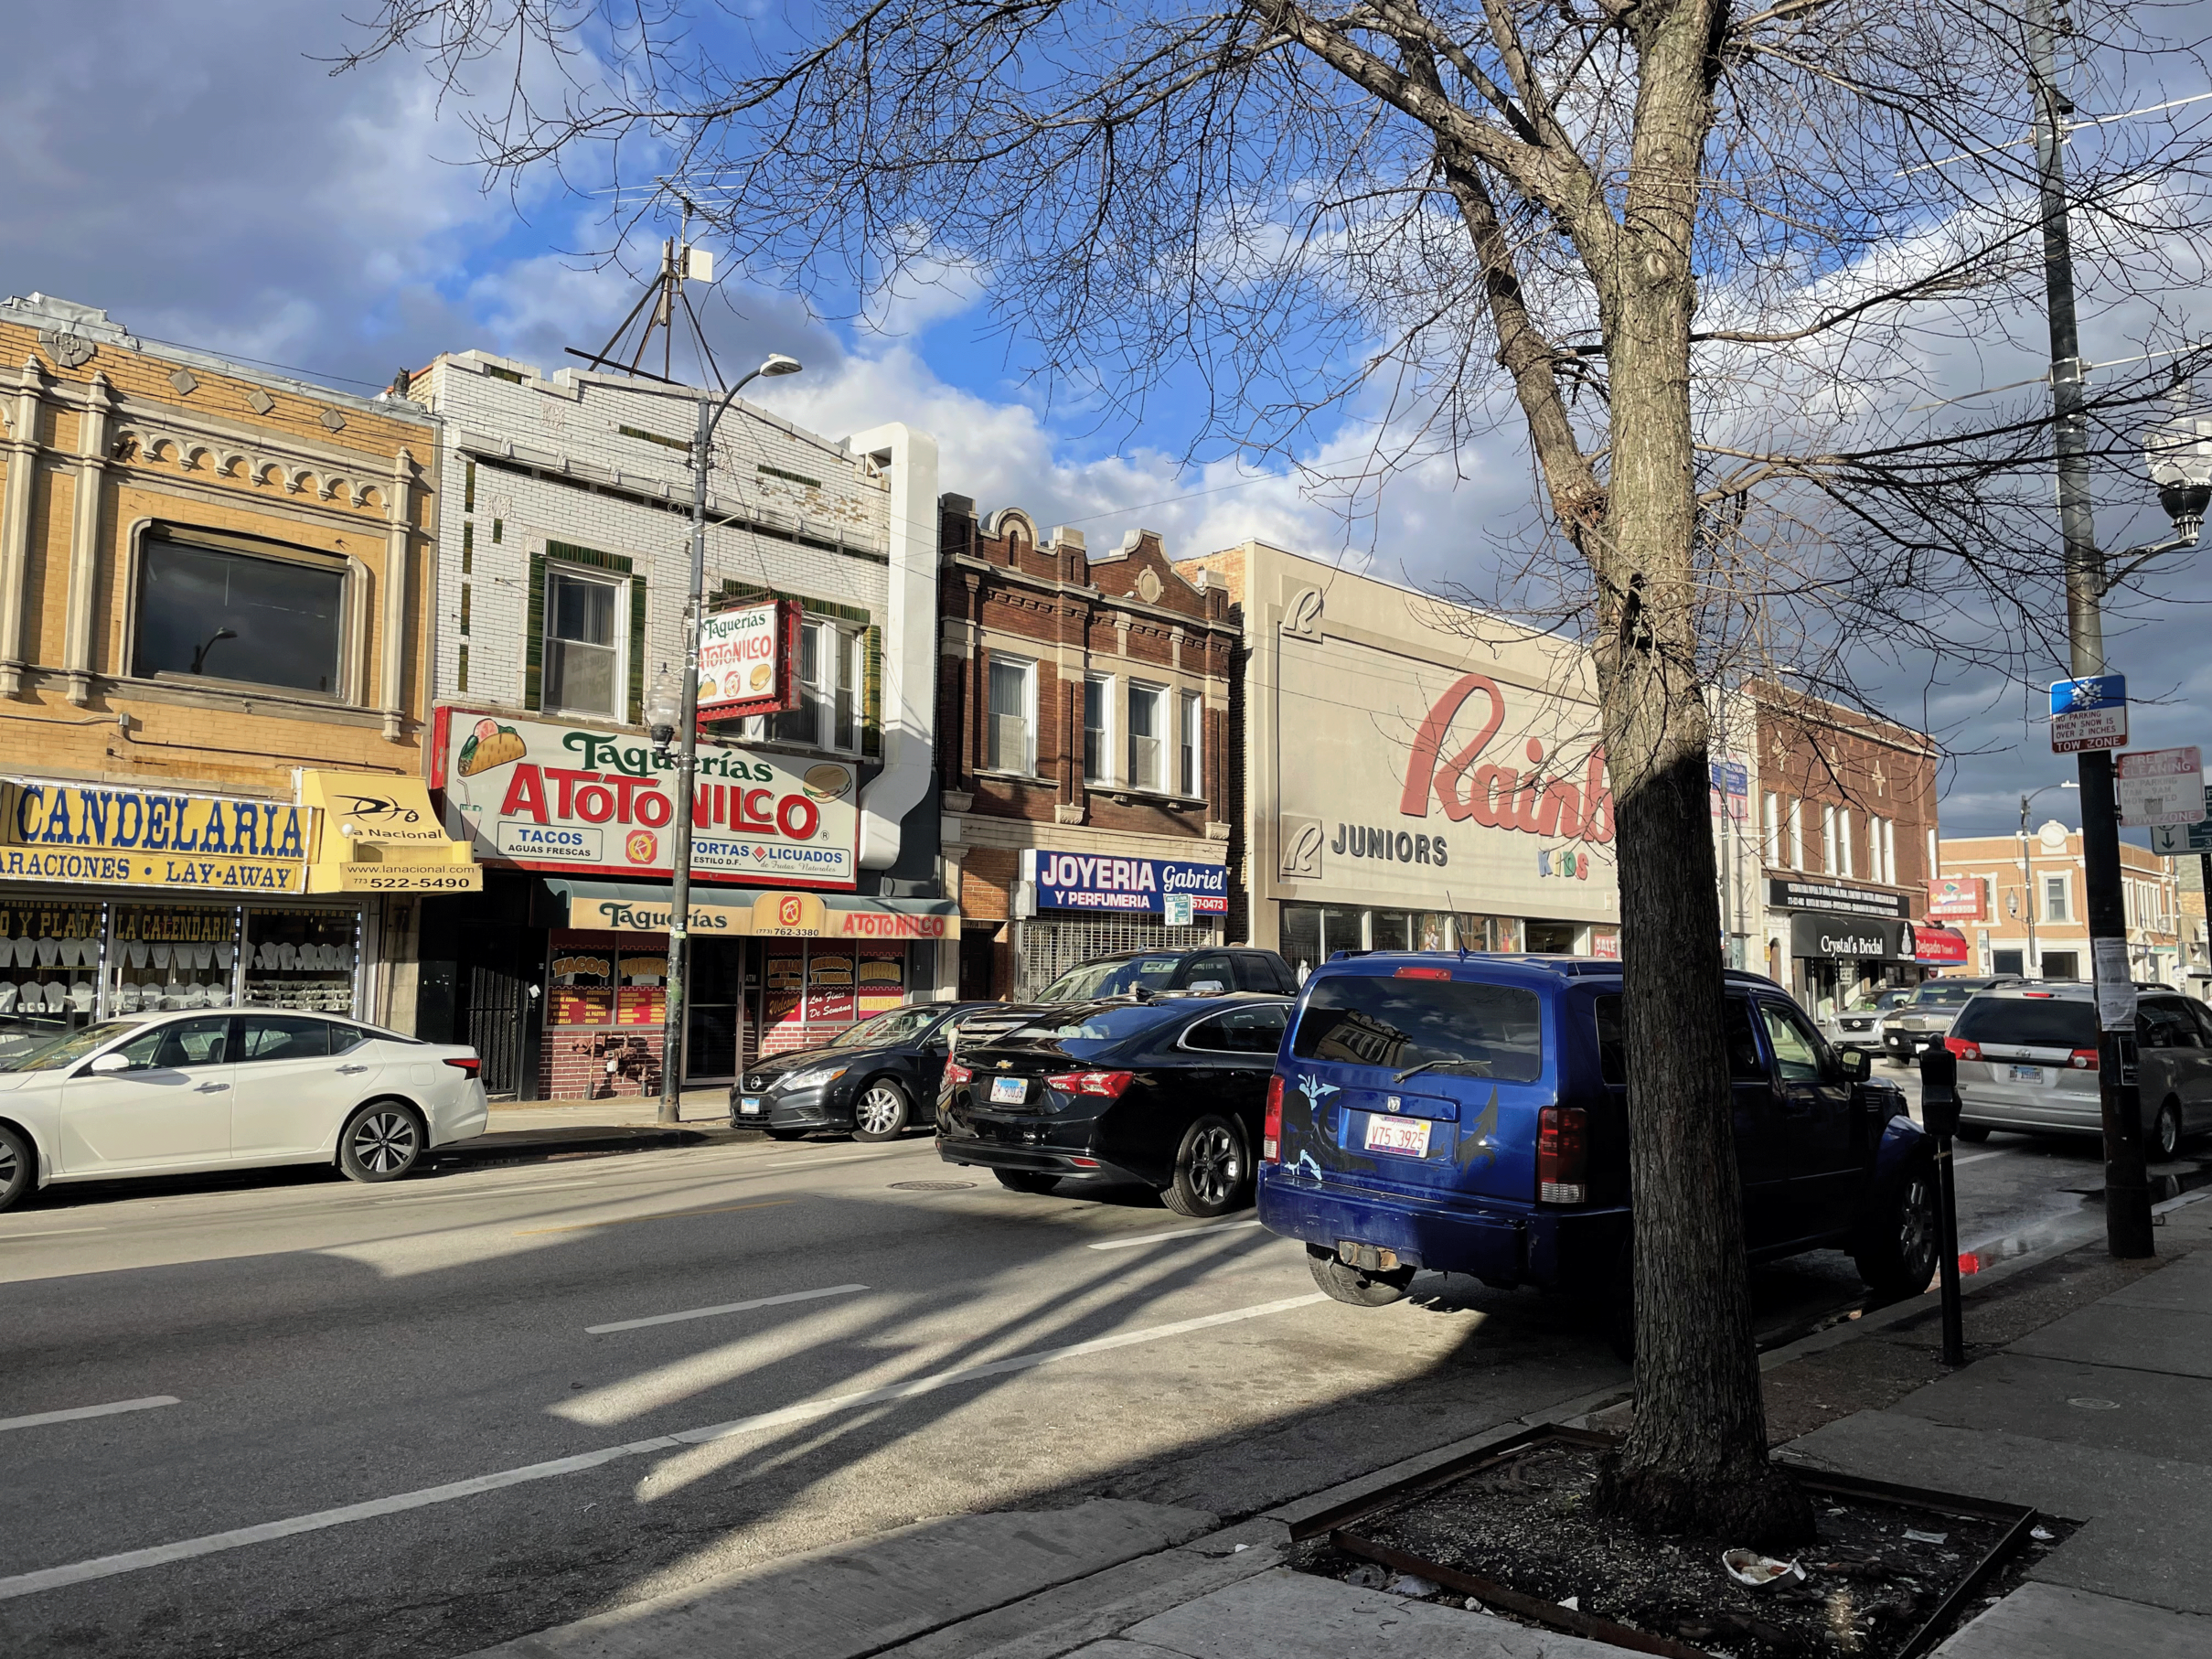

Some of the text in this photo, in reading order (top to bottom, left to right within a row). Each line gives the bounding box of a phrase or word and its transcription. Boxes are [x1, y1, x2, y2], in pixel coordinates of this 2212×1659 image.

[701, 611, 766, 640] Taquerías
[2056, 717, 2114, 731] WHEN SNOW IS
[2069, 711, 2101, 721] PARKING
[2056, 730, 2075, 739] OVER
[2088, 724, 2116, 735] INCHES
[2057, 735, 2121, 752] TOW ZONE
[1400, 673, 1618, 843] Rainb
[2121, 761, 2191, 777] CLEANING
[2140, 777, 2177, 787] PARKING
[500, 763, 819, 840] ATOTONILCO
[17, 785, 304, 858] CANDELARIA
[2160, 810, 2196, 822] ZONE
[369, 829, 442, 839] Nacional
[518, 829, 583, 845] TACOS
[508, 844, 591, 856] AGUAS FRESCAS
[1331, 823, 1448, 866] JUNIORS
[694, 856, 724, 865] ESTILO
[769, 848, 842, 863] LICUADOS
[347, 865, 475, 873] www.lanacional.com
[772, 860, 795, 870] Frutas
[799, 862, 837, 872] Naturales
[1042, 854, 1156, 892] JOYERIA
[1538, 850, 1588, 881] KIDS
[370, 878, 469, 888] 522-5490
[1162, 865, 1223, 892] Gabriel
[1055, 891, 1150, 908] Y PERFUMERIA
[599, 902, 727, 929] Taquías
[19, 911, 33, 937] Y
[38, 912, 102, 937] PLATA
[116, 914, 236, 941] LA CALENDARIA
[842, 913, 945, 937] ATOTONILCO
[775, 928, 819, 937] 762-3380
[1597, 937, 1616, 953] SALE
[1821, 935, 1884, 958] Crystal's Bridal
[1916, 940, 1941, 957] Delgado
[552, 956, 610, 978] TACOS
[619, 958, 668, 979] TORTA
[809, 957, 852, 972] MENUDO
[860, 962, 901, 982] BIRRIA
[745, 974, 756, 982] ATM
[810, 972, 819, 984] Y
[819, 972, 852, 984] BIRRIA
[769, 995, 800, 1015] Welcome
[808, 991, 845, 1004] Los Fines
[809, 1004, 851, 1018] De Semana
[1373, 1127, 1392, 1145] V75
[1398, 1129, 1425, 1150] 3925
